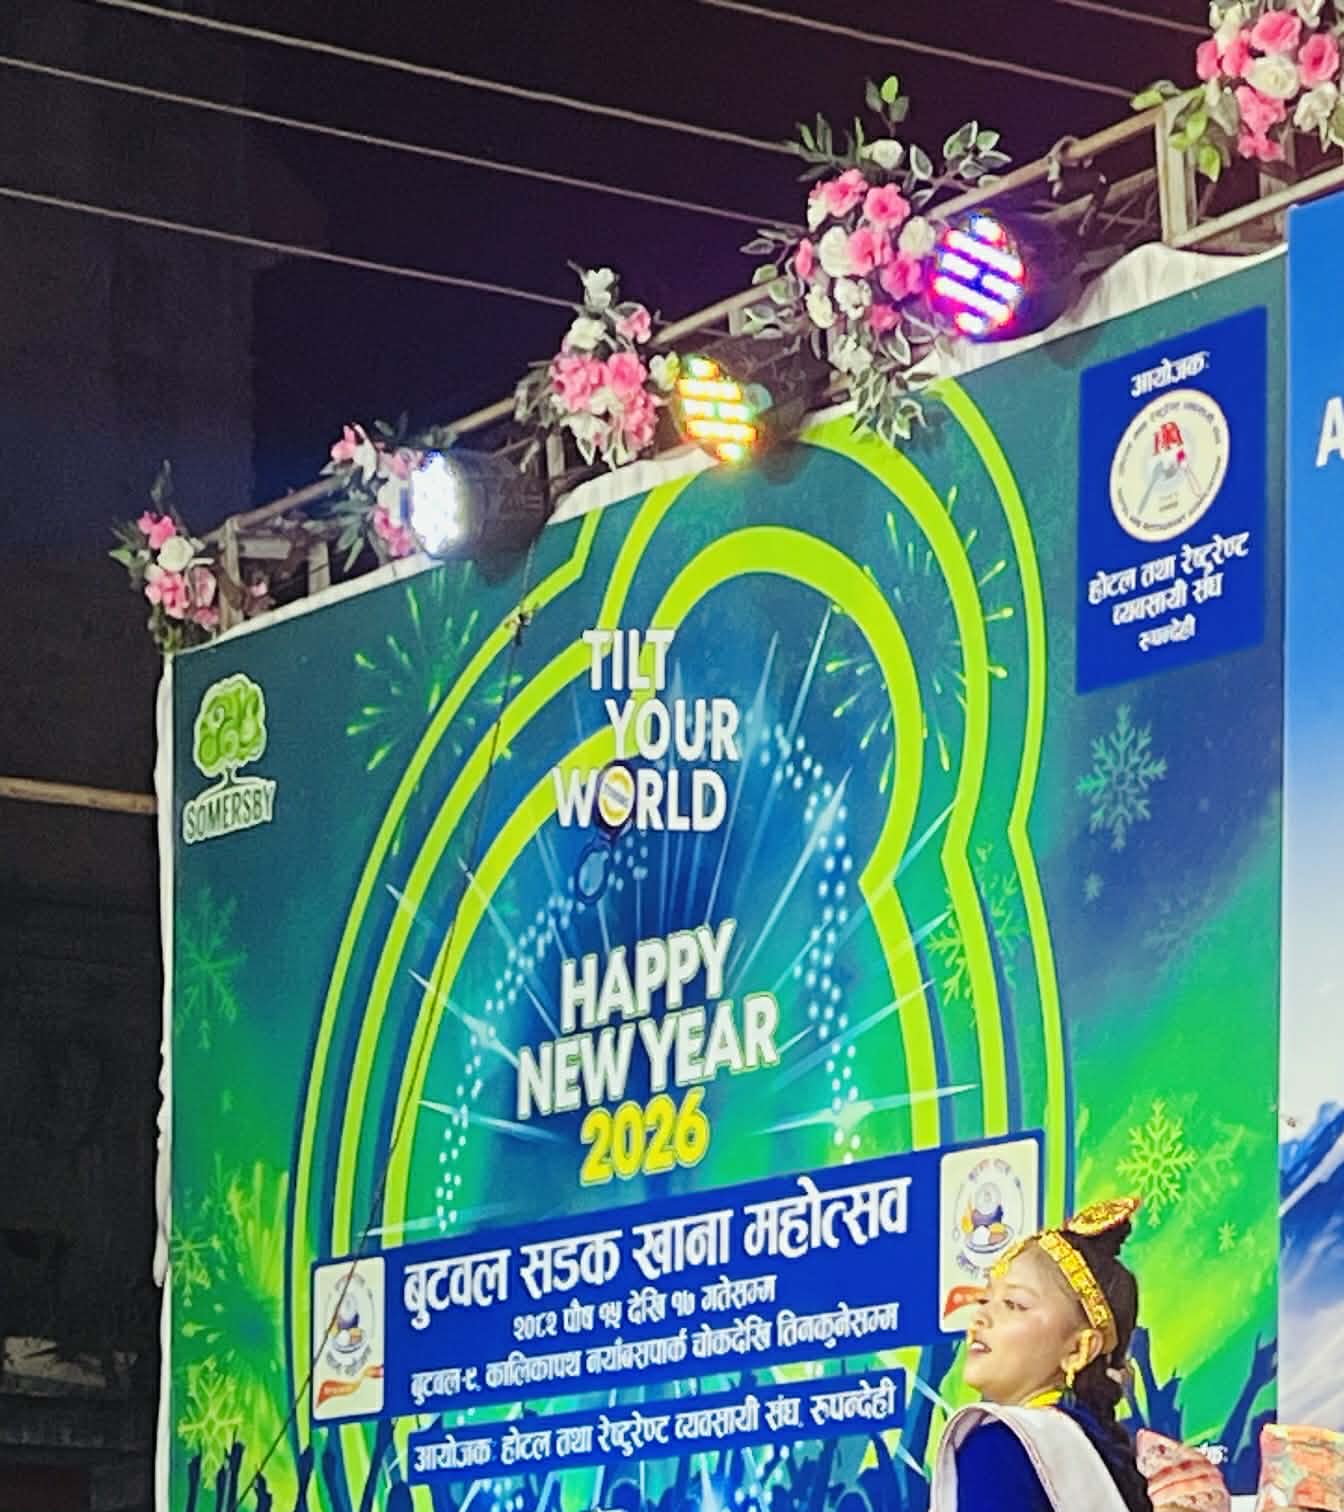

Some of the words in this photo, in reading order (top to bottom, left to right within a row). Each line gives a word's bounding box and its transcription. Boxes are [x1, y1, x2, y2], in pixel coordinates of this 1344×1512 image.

[582, 629, 675, 691] TILT
[605, 698, 740, 763] YOUR
[186, 783, 275, 840] SOMERSBY
[552, 765, 728, 832] WORLD
[561, 919, 737, 1034] HAPPY
[516, 1020, 638, 1120] NEW
[638, 992, 779, 1091] YEAR
[580, 1087, 711, 1186] 2026
[403, 1249, 512, 1331] बुटवल
[519, 1229, 624, 1300] सडक
[632, 1208, 735, 1280] खाना
[743, 1175, 913, 1259] महोत्सव
[627, 1286, 668, 1325] देखि
[701, 1274, 778, 1313] गतेसम्म
[500, 1425, 553, 1466] होटल
[556, 1424, 594, 1457] तथा
[674, 1394, 761, 1440] व्यवसायी
